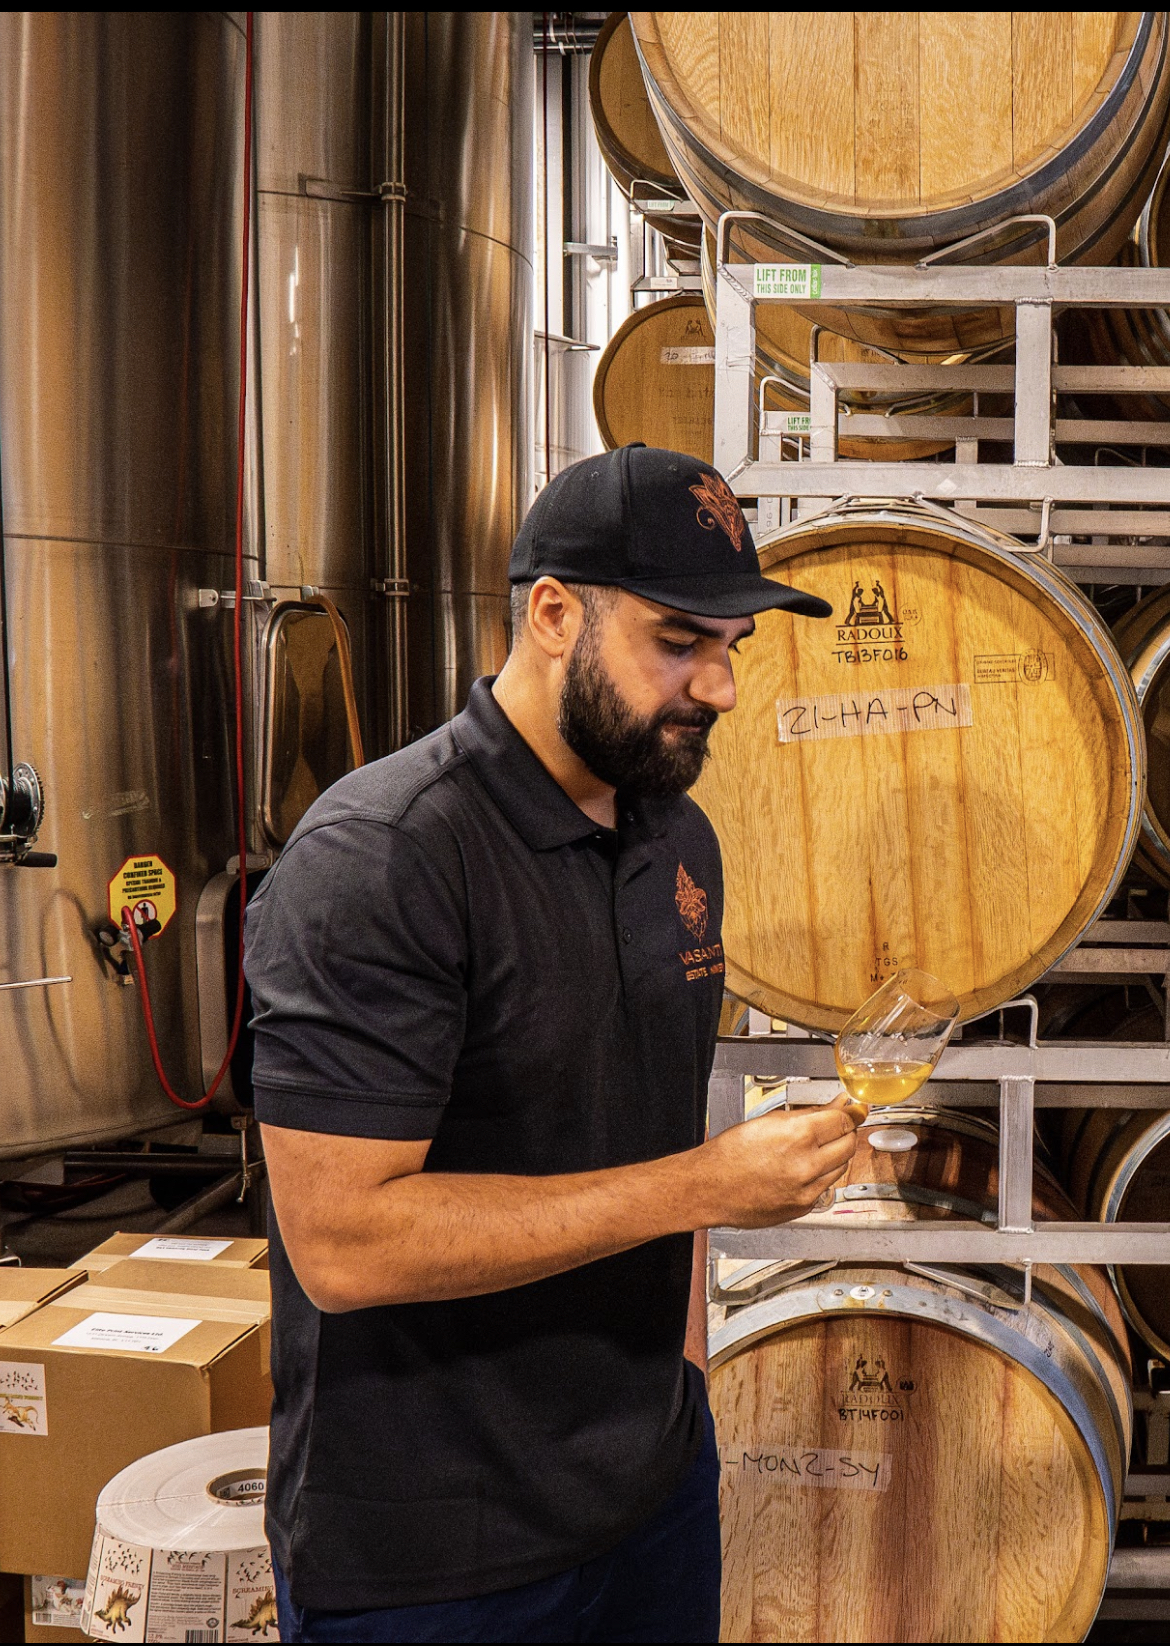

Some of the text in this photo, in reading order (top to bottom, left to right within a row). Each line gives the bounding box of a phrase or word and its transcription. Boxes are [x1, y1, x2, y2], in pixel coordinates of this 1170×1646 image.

[756, 268, 807, 282] LIFT FROM
[756, 283, 806, 294] THIS SIDE ONLY
[787, 416, 800, 424] LIFT
[837, 626, 904, 642] RADOUX
[832, 649, 908, 664] TB13F016
[123, 871, 147, 879] CONFINED
[882, 941, 890, 951] R
[839, 1408, 904, 1421] BT14F001
[238, 1482, 264, 1492] 4060
